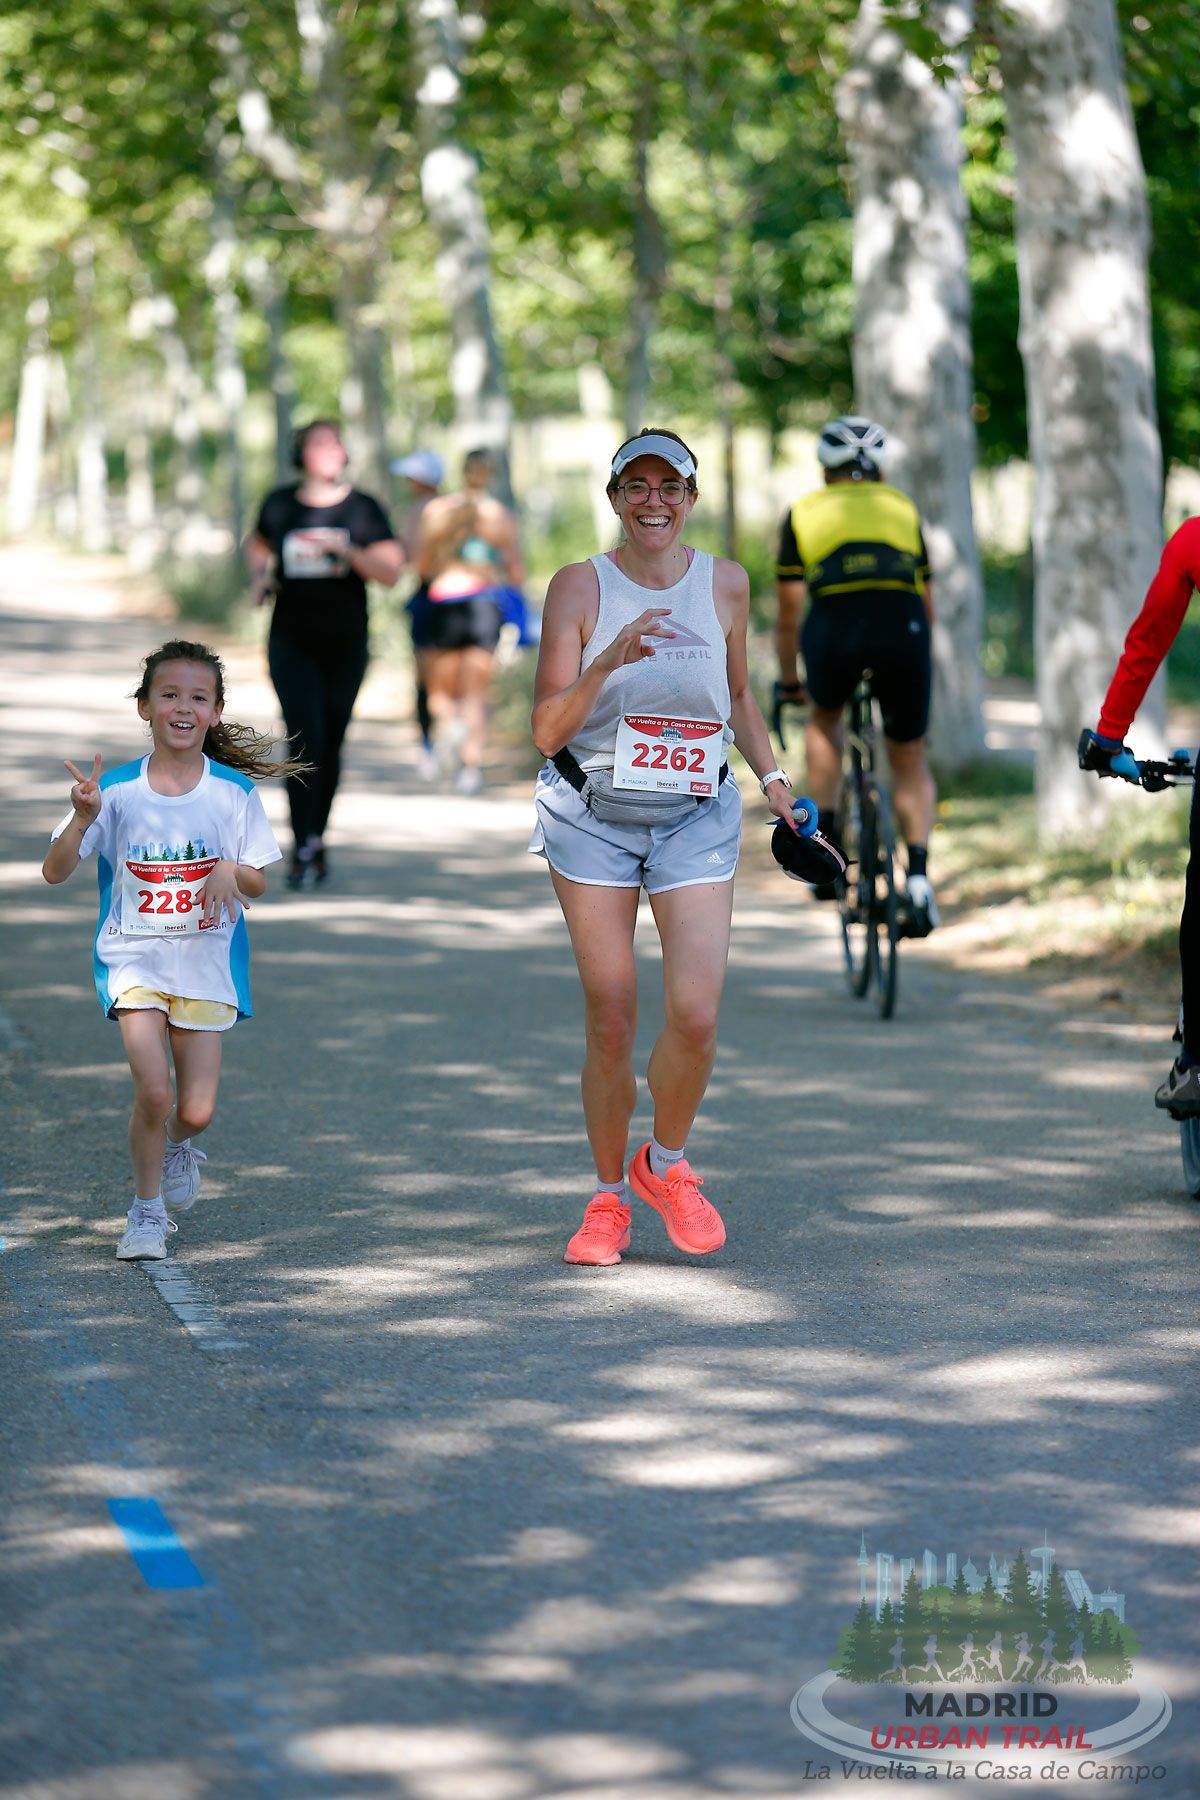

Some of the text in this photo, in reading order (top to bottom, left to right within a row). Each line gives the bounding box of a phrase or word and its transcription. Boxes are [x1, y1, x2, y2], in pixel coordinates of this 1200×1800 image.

[664, 649, 711, 661] TRAIL
[695, 723, 717, 731] Campo
[631, 743, 705, 773] 2262
[197, 861, 216, 870] Campo
[108, 926, 118, 935] La
